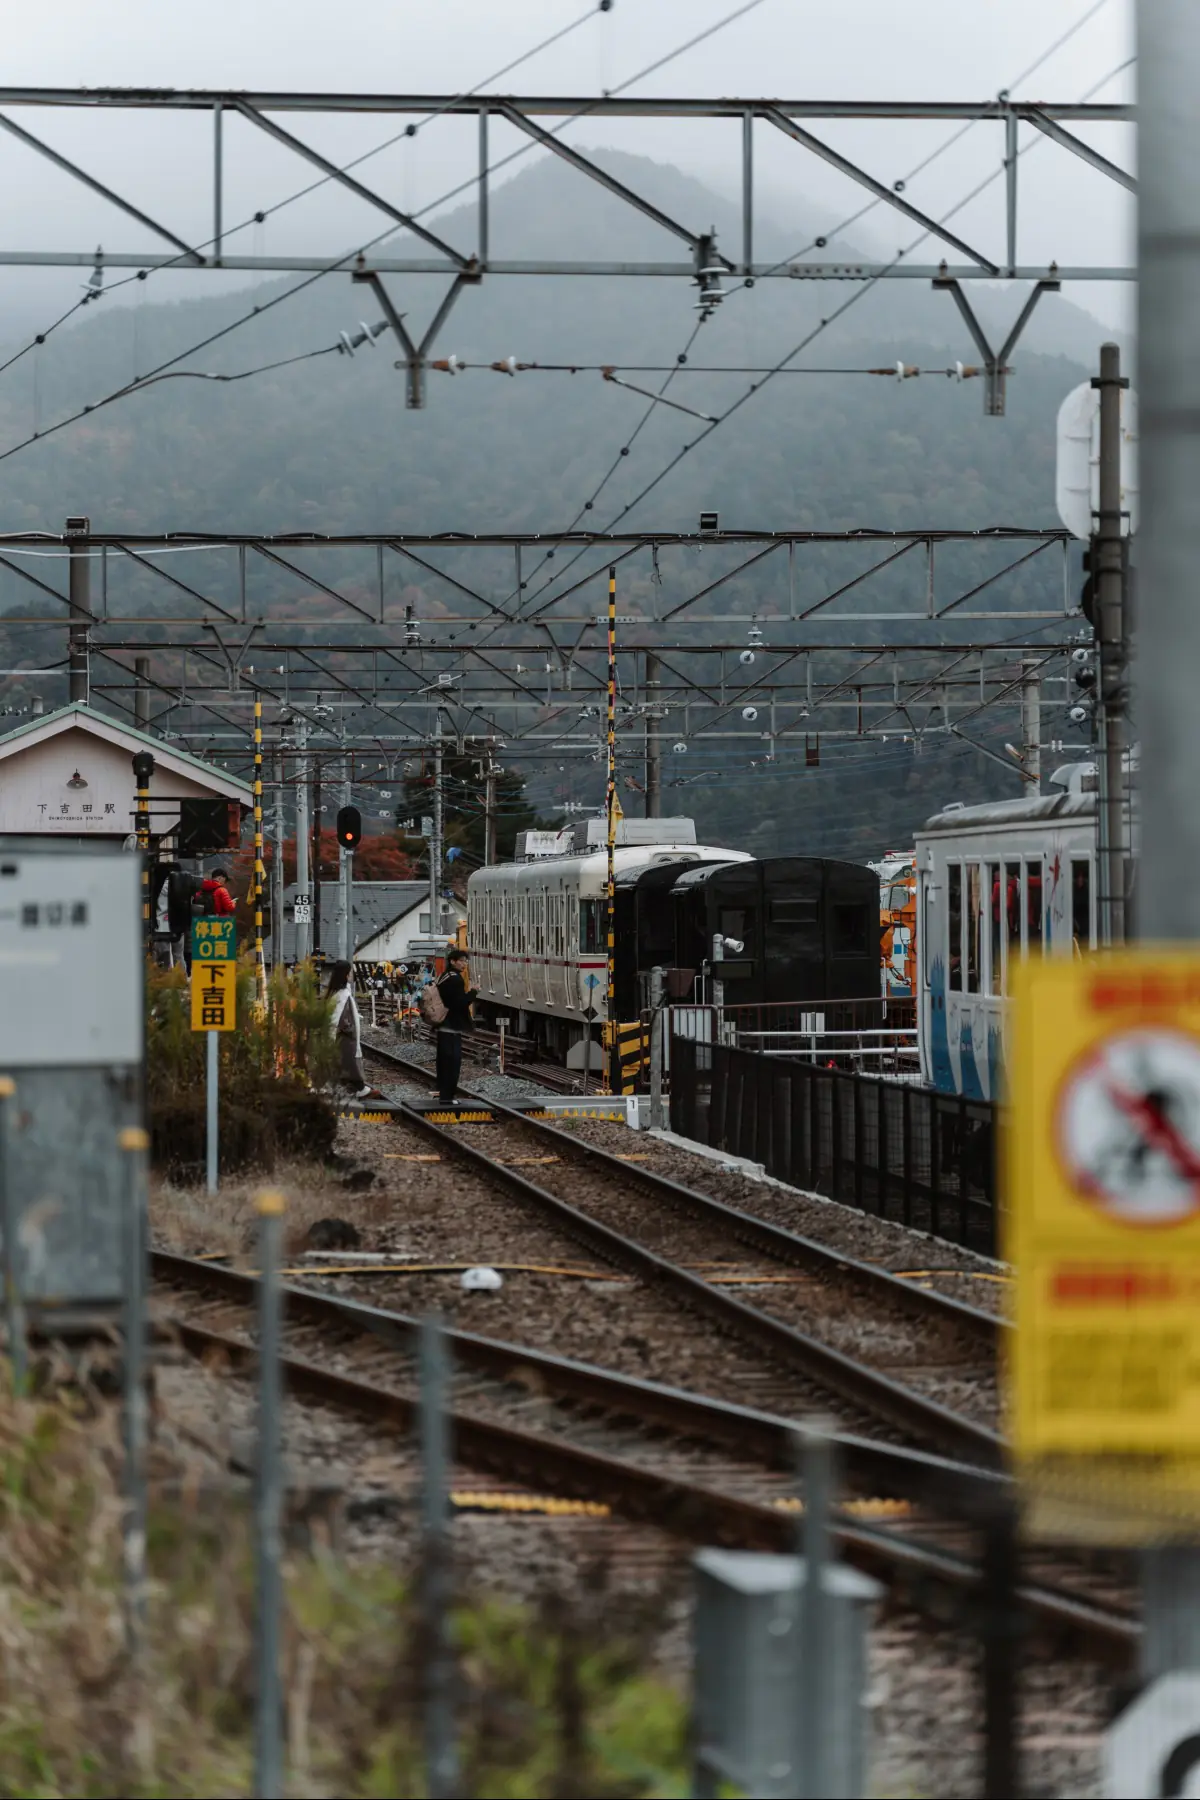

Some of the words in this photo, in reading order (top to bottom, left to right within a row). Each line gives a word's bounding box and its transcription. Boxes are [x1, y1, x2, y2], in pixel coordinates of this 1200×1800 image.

[37, 803, 115, 814] 下吉田駅
[295, 895, 309, 905] 45
[296, 906, 309, 915] 45
[201, 964, 226, 1026] 下吉田
